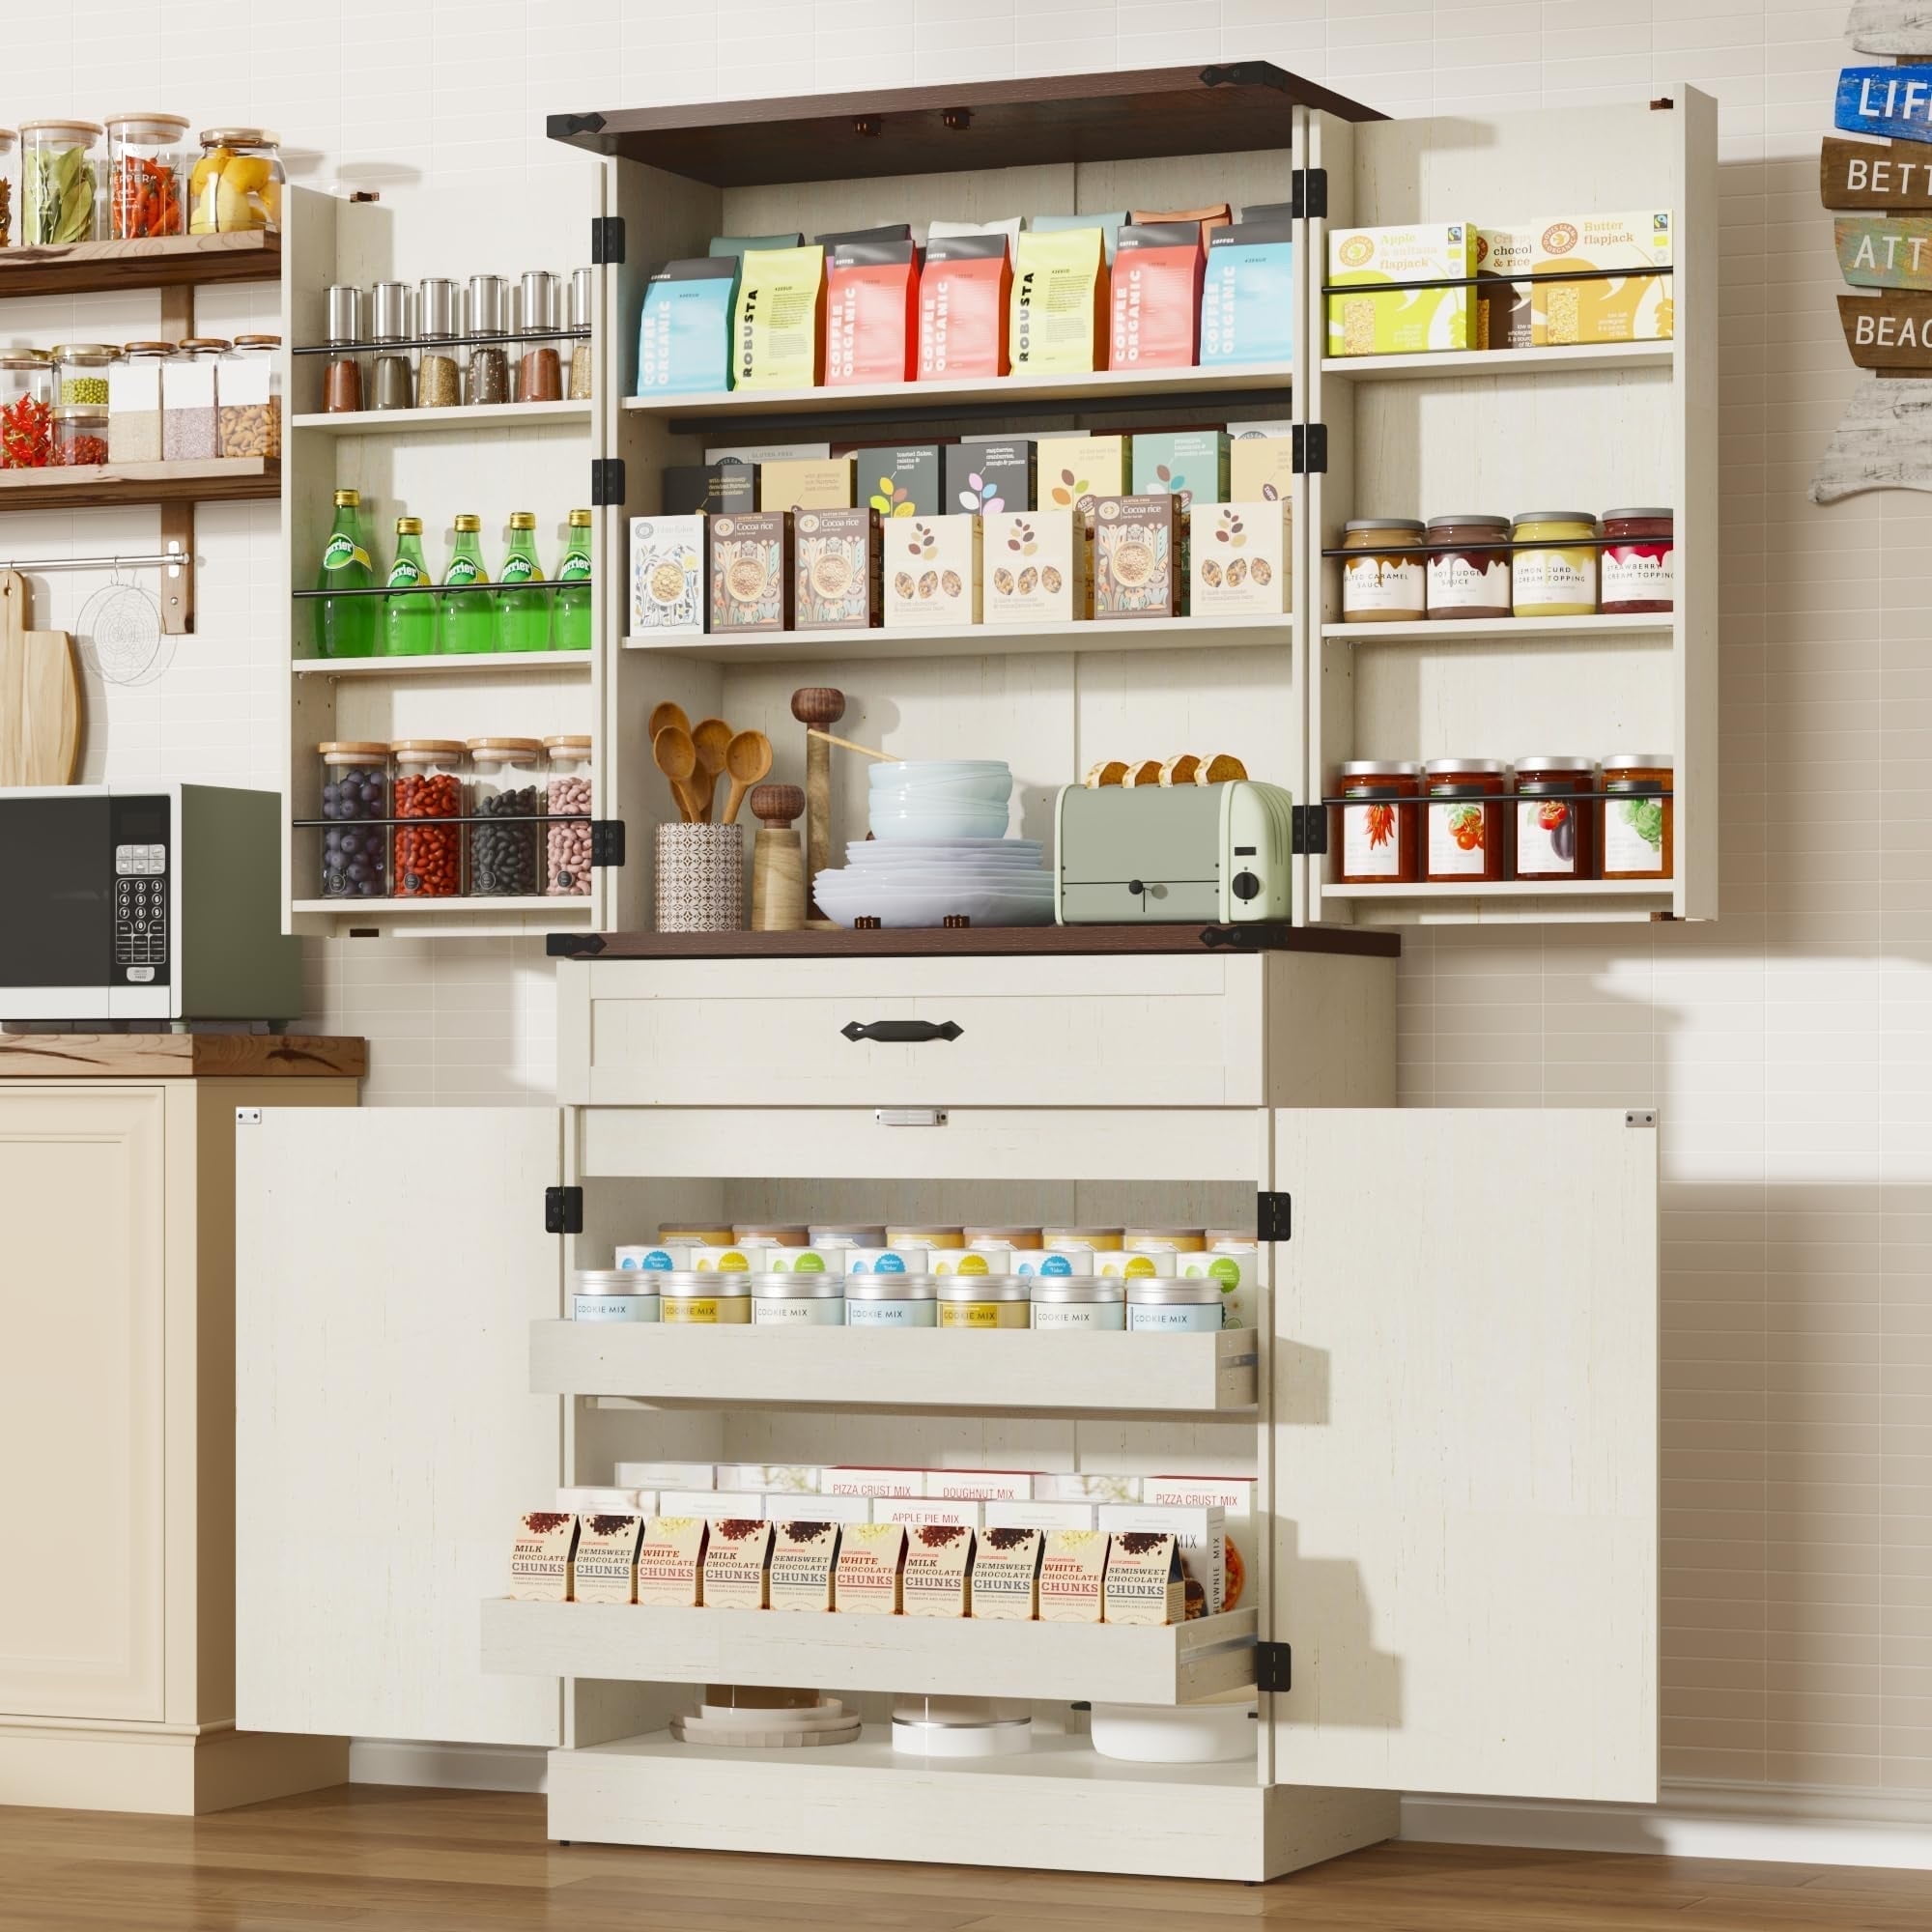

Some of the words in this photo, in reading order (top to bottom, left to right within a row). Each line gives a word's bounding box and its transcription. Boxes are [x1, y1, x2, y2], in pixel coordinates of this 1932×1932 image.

[1859, 78, 1932, 121] LIF
[1583, 220, 1624, 232] Butter
[1583, 232, 1634, 247] flapjack
[1853, 235, 1928, 271] ATT
[1379, 258, 1430, 270] flapjack
[1493, 259, 1504, 268] &
[1507, 258, 1530, 267] rice
[1127, 270, 1141, 361] ORGANIC
[1221, 265, 1236, 355] ORGANIC
[1018, 272, 1035, 362] ROBUSTA
[1207, 282, 1219, 355] COFFEE
[935, 281, 949, 371] ORGANIC
[1115, 288, 1127, 361] COFFEE
[743, 289, 758, 378] ROBUSTA
[843, 287, 856, 377] ORGANIC
[923, 298, 935, 371] COFFEE
[1855, 315, 1932, 348] BEAC
[657, 300, 670, 384] ORGANIC
[831, 304, 842, 377] COFFEE
[643, 317, 656, 385] COFFEE
[1122, 505, 1147, 514] Cocoa
[1148, 504, 1162, 514] rice
[736, 523, 759, 531] Cocoa
[761, 522, 774, 530] rice
[821, 518, 844, 526] Cocoa
[845, 518, 860, 526] rice
[1548, 573, 1585, 582] TOPPING
[578, 1305, 606, 1314] COOKIE
[609, 1304, 626, 1314] MIX
[666, 1306, 695, 1316] COOKIE
[696, 1306, 717, 1316] MIX
[757, 1308, 786, 1317] COOKIE
[789, 1307, 808, 1317] MIX
[852, 1309, 882, 1319] COOKIE
[885, 1309, 903, 1319] MIX
[944, 1311, 974, 1321] COOKIE
[977, 1311, 996, 1321] MIX
[1037, 1313, 1068, 1321] COOKIE
[1071, 1313, 1090, 1321] MIX
[1134, 1314, 1167, 1323] COOKIE
[1170, 1314, 1188, 1323] MIX
[833, 1484, 859, 1495] PIZZA
[861, 1485, 892, 1496] CRUST
[894, 1486, 911, 1496] MIX
[943, 1487, 995, 1499] DOUGHNUT
[997, 1488, 1014, 1499] MIX
[1156, 1493, 1182, 1505] PIZZA
[1185, 1493, 1217, 1506] CRUST
[1220, 1495, 1237, 1506] MIX
[892, 1512, 921, 1523] APPLE
[924, 1513, 940, 1523] PIE
[942, 1514, 959, 1524] MIX
[642, 1549, 680, 1558] WHITE
[1212, 1537, 1221, 1559] MIX
[512, 1553, 565, 1562] CHOCOLATE
[708, 1551, 737, 1560] MILK
[840, 1556, 879, 1565] WHITE
[512, 1562, 565, 1573] CHUNKS
[576, 1565, 630, 1575] CHUNKS
[639, 1567, 694, 1577] CHUNKS
[976, 1562, 1033, 1571] SEMISWEET
[1043, 1564, 1083, 1573] WHITE
[1109, 1567, 1167, 1576] SEMISWEET
[705, 1570, 760, 1580] CHUNKS
[772, 1572, 827, 1582] CHUNKS
[838, 1575, 893, 1585] CHUNKS
[974, 1571, 1031, 1579] CHOCOLATE
[1107, 1576, 1165, 1584] CHOCOLATE
[905, 1577, 961, 1587] CHUNKS
[974, 1579, 1030, 1590] CHUNKS
[1041, 1582, 1098, 1593] CHUNKS
[1106, 1584, 1164, 1595] CHUNKS
[1212, 1566, 1221, 1614] ROWNIE
